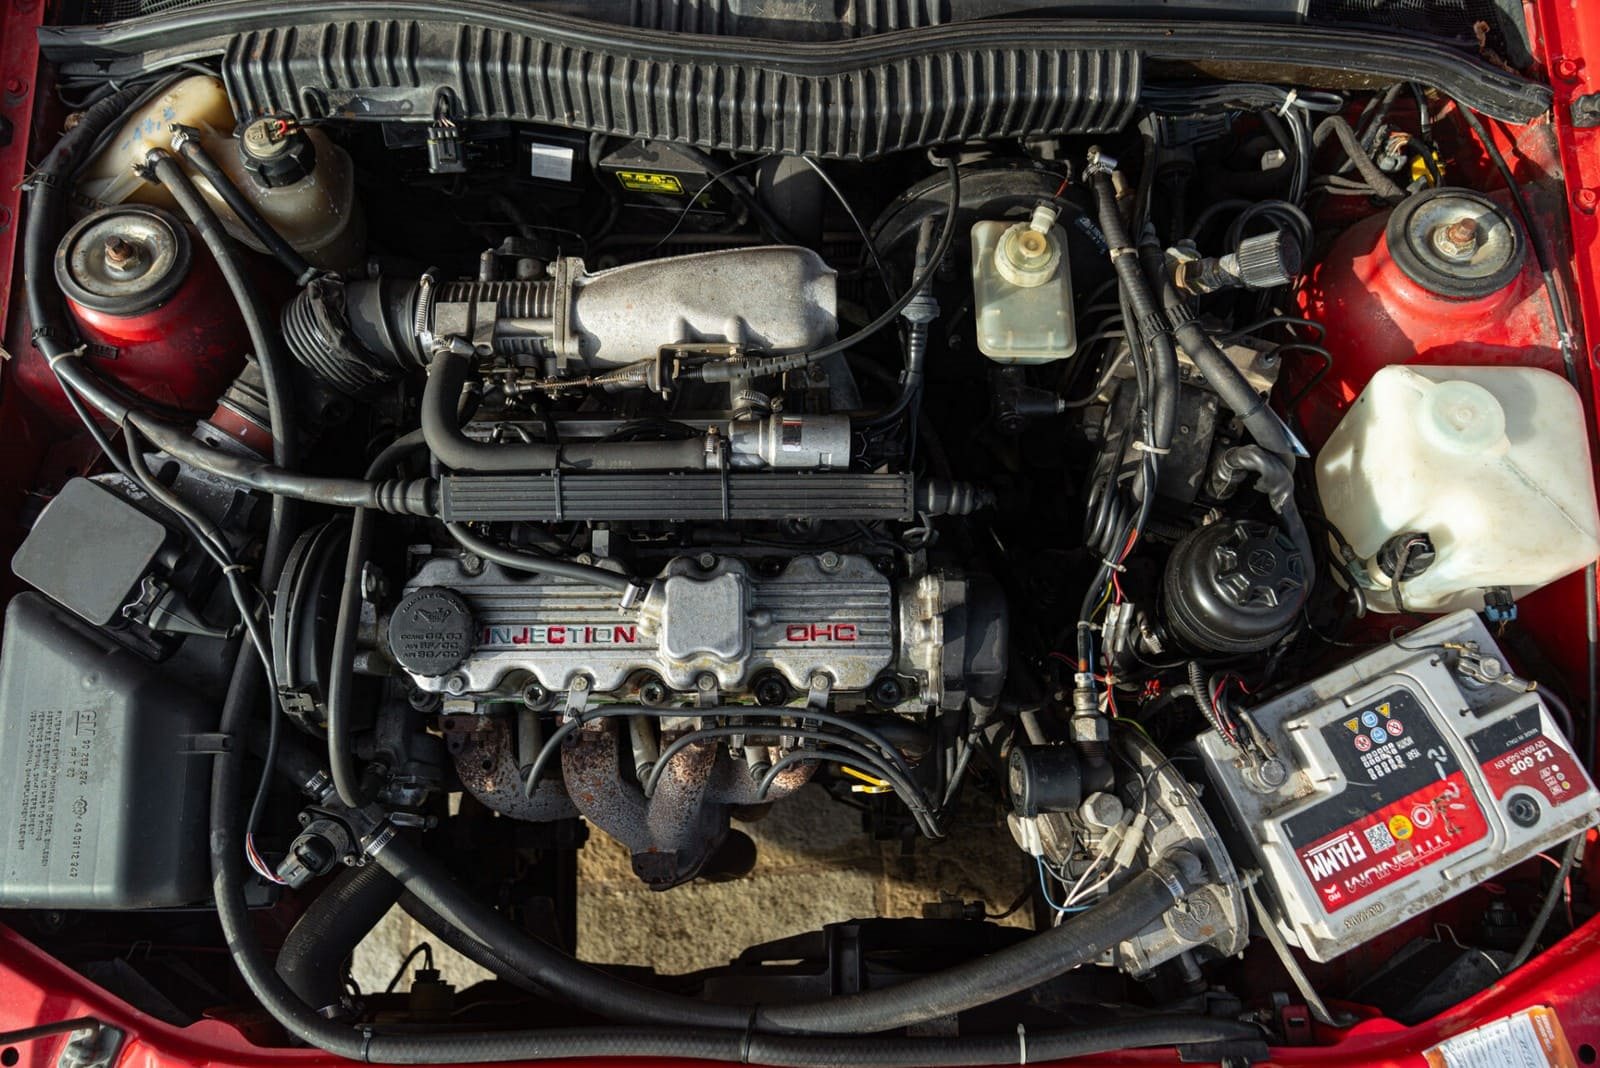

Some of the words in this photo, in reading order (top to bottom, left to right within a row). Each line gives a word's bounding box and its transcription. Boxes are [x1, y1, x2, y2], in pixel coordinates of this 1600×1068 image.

[483, 625, 637, 644] INJECTION
[785, 624, 858, 642] OHC
[1534, 746, 1554, 762] L2
[1509, 756, 1535, 776] 60P
[1304, 835, 1367, 881] FIAMM
[1344, 834, 1452, 894] TITANIUM
[1327, 891, 1342, 902] PRO
